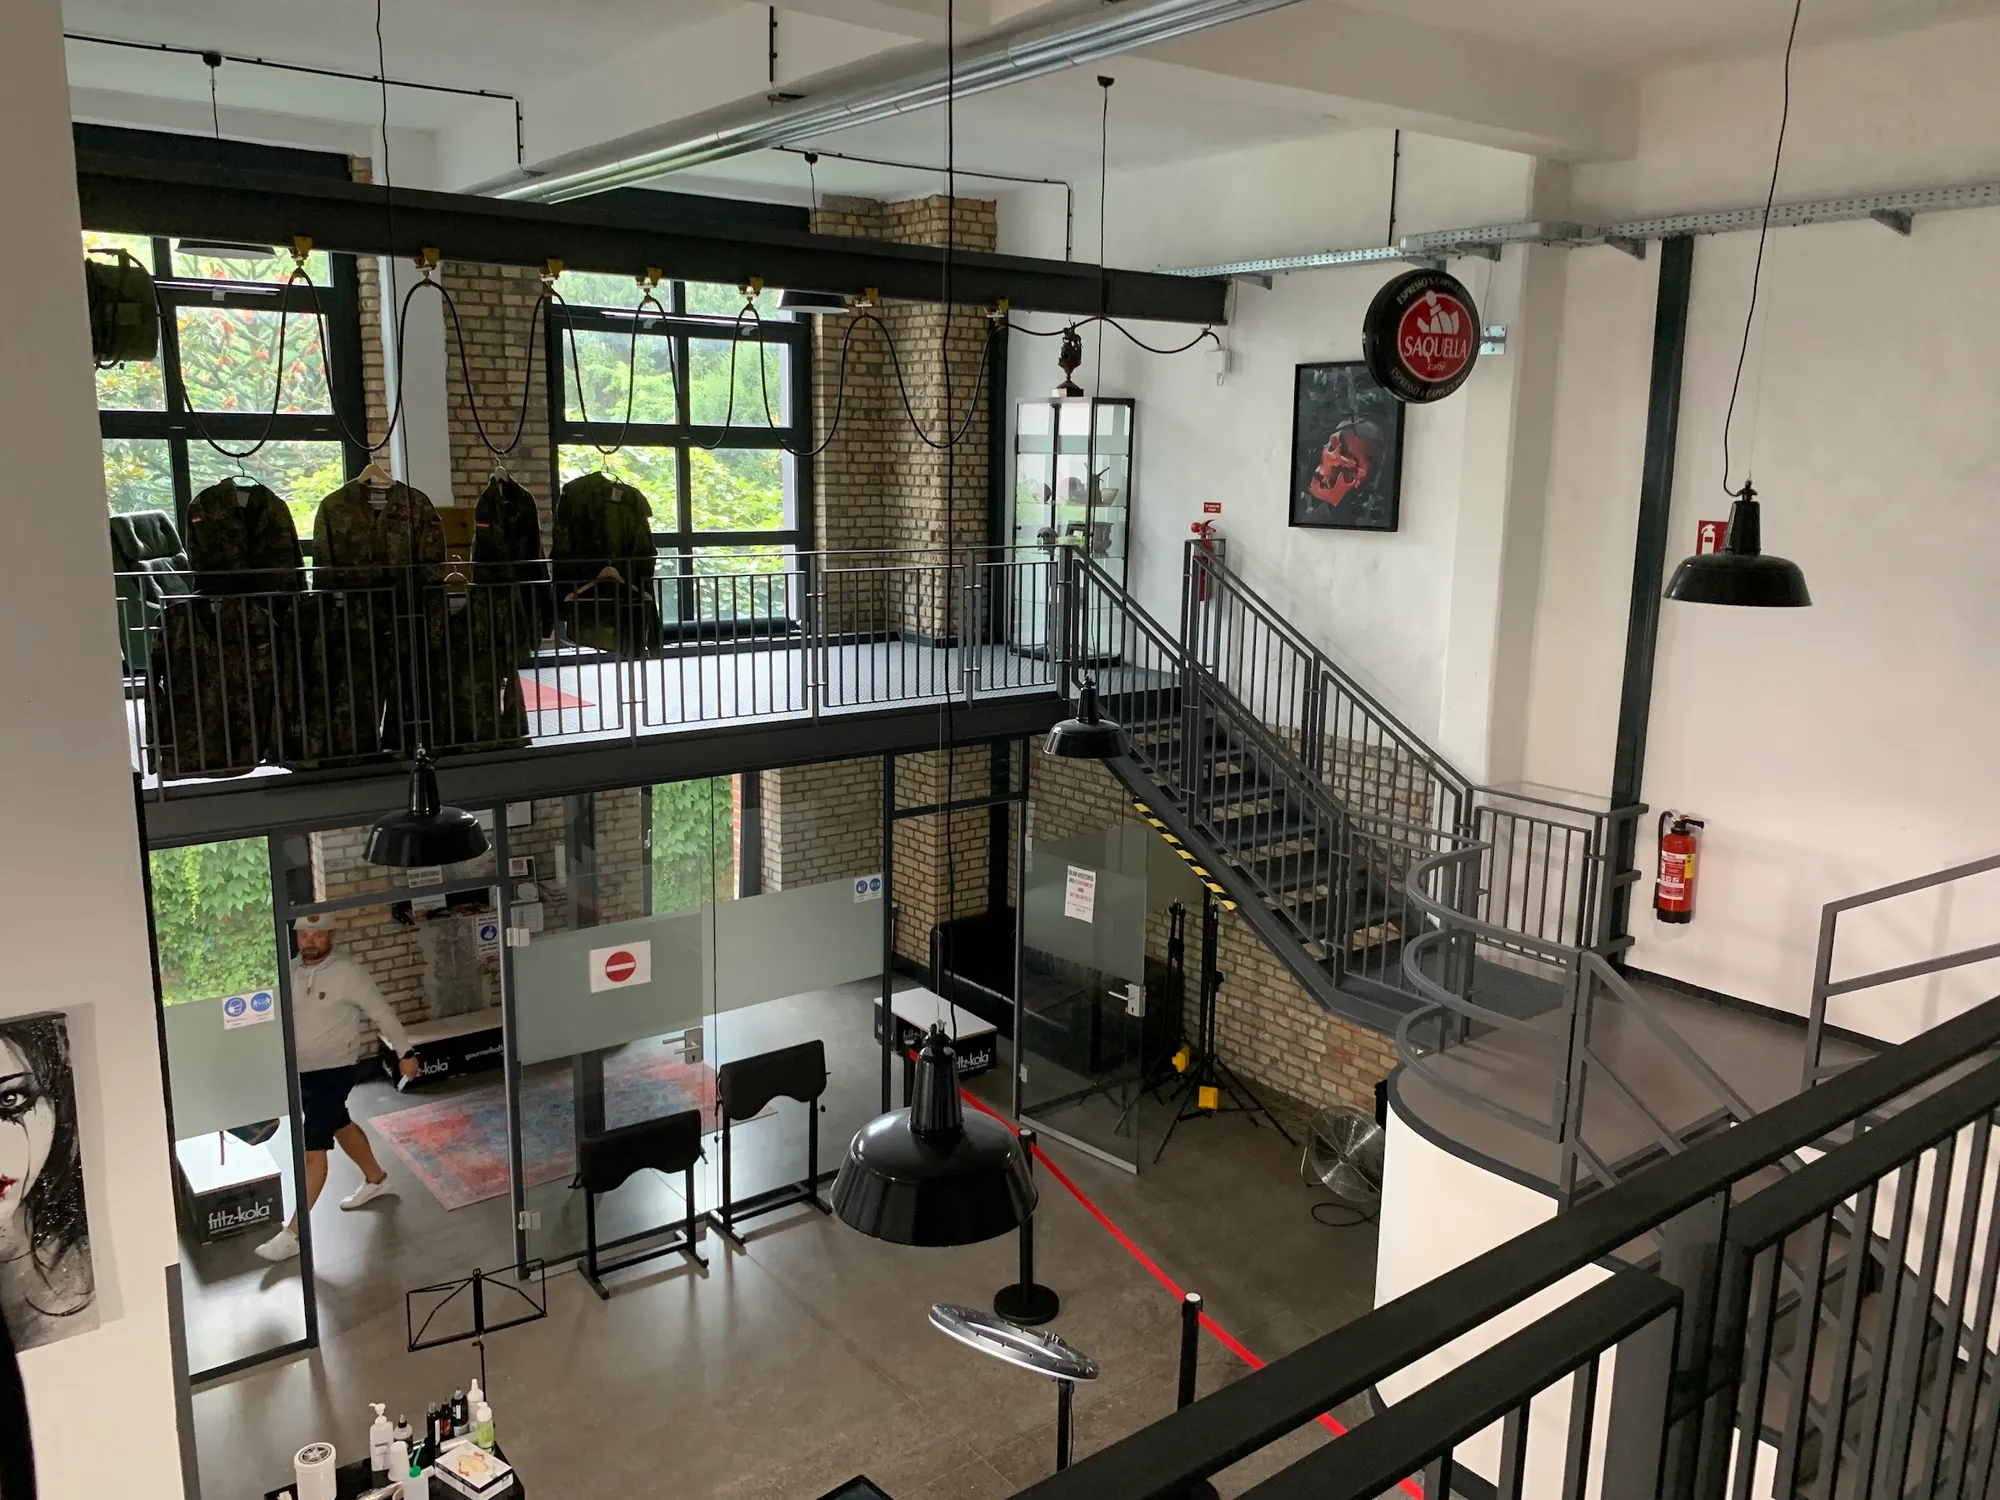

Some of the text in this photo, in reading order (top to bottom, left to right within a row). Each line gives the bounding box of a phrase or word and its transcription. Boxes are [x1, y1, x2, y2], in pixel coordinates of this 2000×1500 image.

[1397, 277, 1428, 305] ESPRESSO
[1403, 335, 1467, 363] SAQUELLA
[1391, 366, 1420, 396] ESPRESSO
[416, 1059, 449, 1077] z-kola
[208, 1201, 271, 1230] fritz-kola
